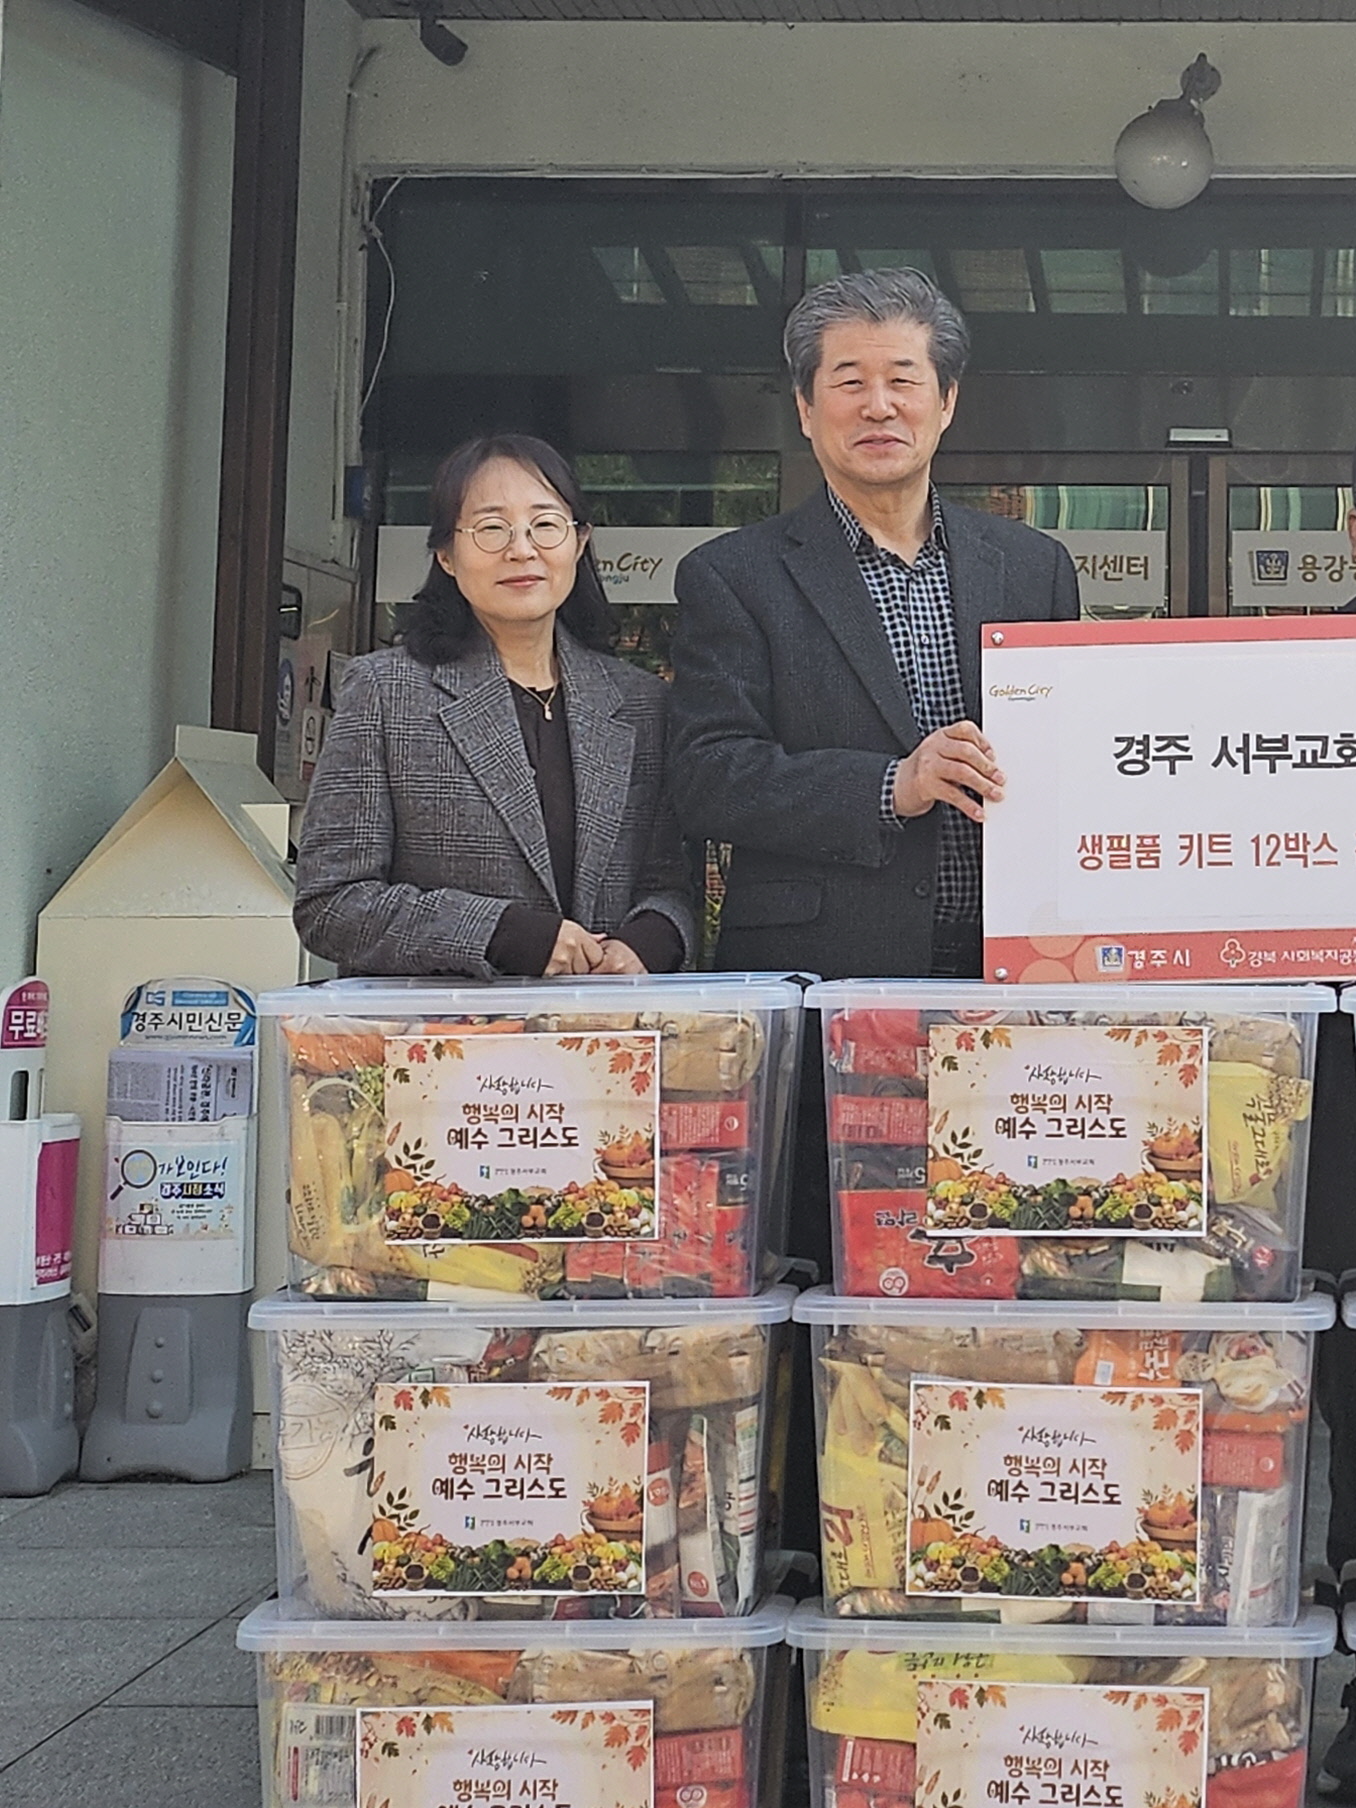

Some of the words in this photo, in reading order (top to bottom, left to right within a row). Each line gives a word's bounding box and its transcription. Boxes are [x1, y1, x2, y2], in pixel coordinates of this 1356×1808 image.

[616, 552, 663, 580] City
[1113, 733, 1193, 776] 경주
[1077, 833, 1161, 871] 생필품
[1178, 832, 1233, 869] 키트
[1250, 832, 1338, 868] 12박스
[1127, 948, 1191, 970] 경주시
[132, 1011, 244, 1033] 경주시민신문
[462, 1103, 519, 1125] 행복의
[527, 1103, 565, 1124] 시작
[1010, 1092, 1067, 1115] 행복의
[1075, 1093, 1113, 1115] 시작
[447, 1127, 489, 1150] 예수
[497, 1126, 579, 1149] 그리스도
[995, 1116, 1037, 1140] 예수
[1045, 1116, 1127, 1140] 그리스도
[448, 1452, 506, 1475] 행복의
[514, 1453, 553, 1475] 시작
[1003, 1454, 1061, 1479] 행복의
[1069, 1457, 1107, 1480] 시작
[432, 1477, 475, 1500] 예수
[483, 1476, 567, 1501] 그리스도
[987, 1478, 1030, 1503] 예수
[1038, 1480, 1121, 1506] 그리스도
[1003, 1755, 1062, 1780] 행복의
[1070, 1758, 1110, 1782] 시작
[452, 1779, 511, 1802] 행복의
[520, 1779, 559, 1801] 시작
[987, 1779, 1031, 1805] 예수
[1039, 1782, 1123, 1808] 그리스도
